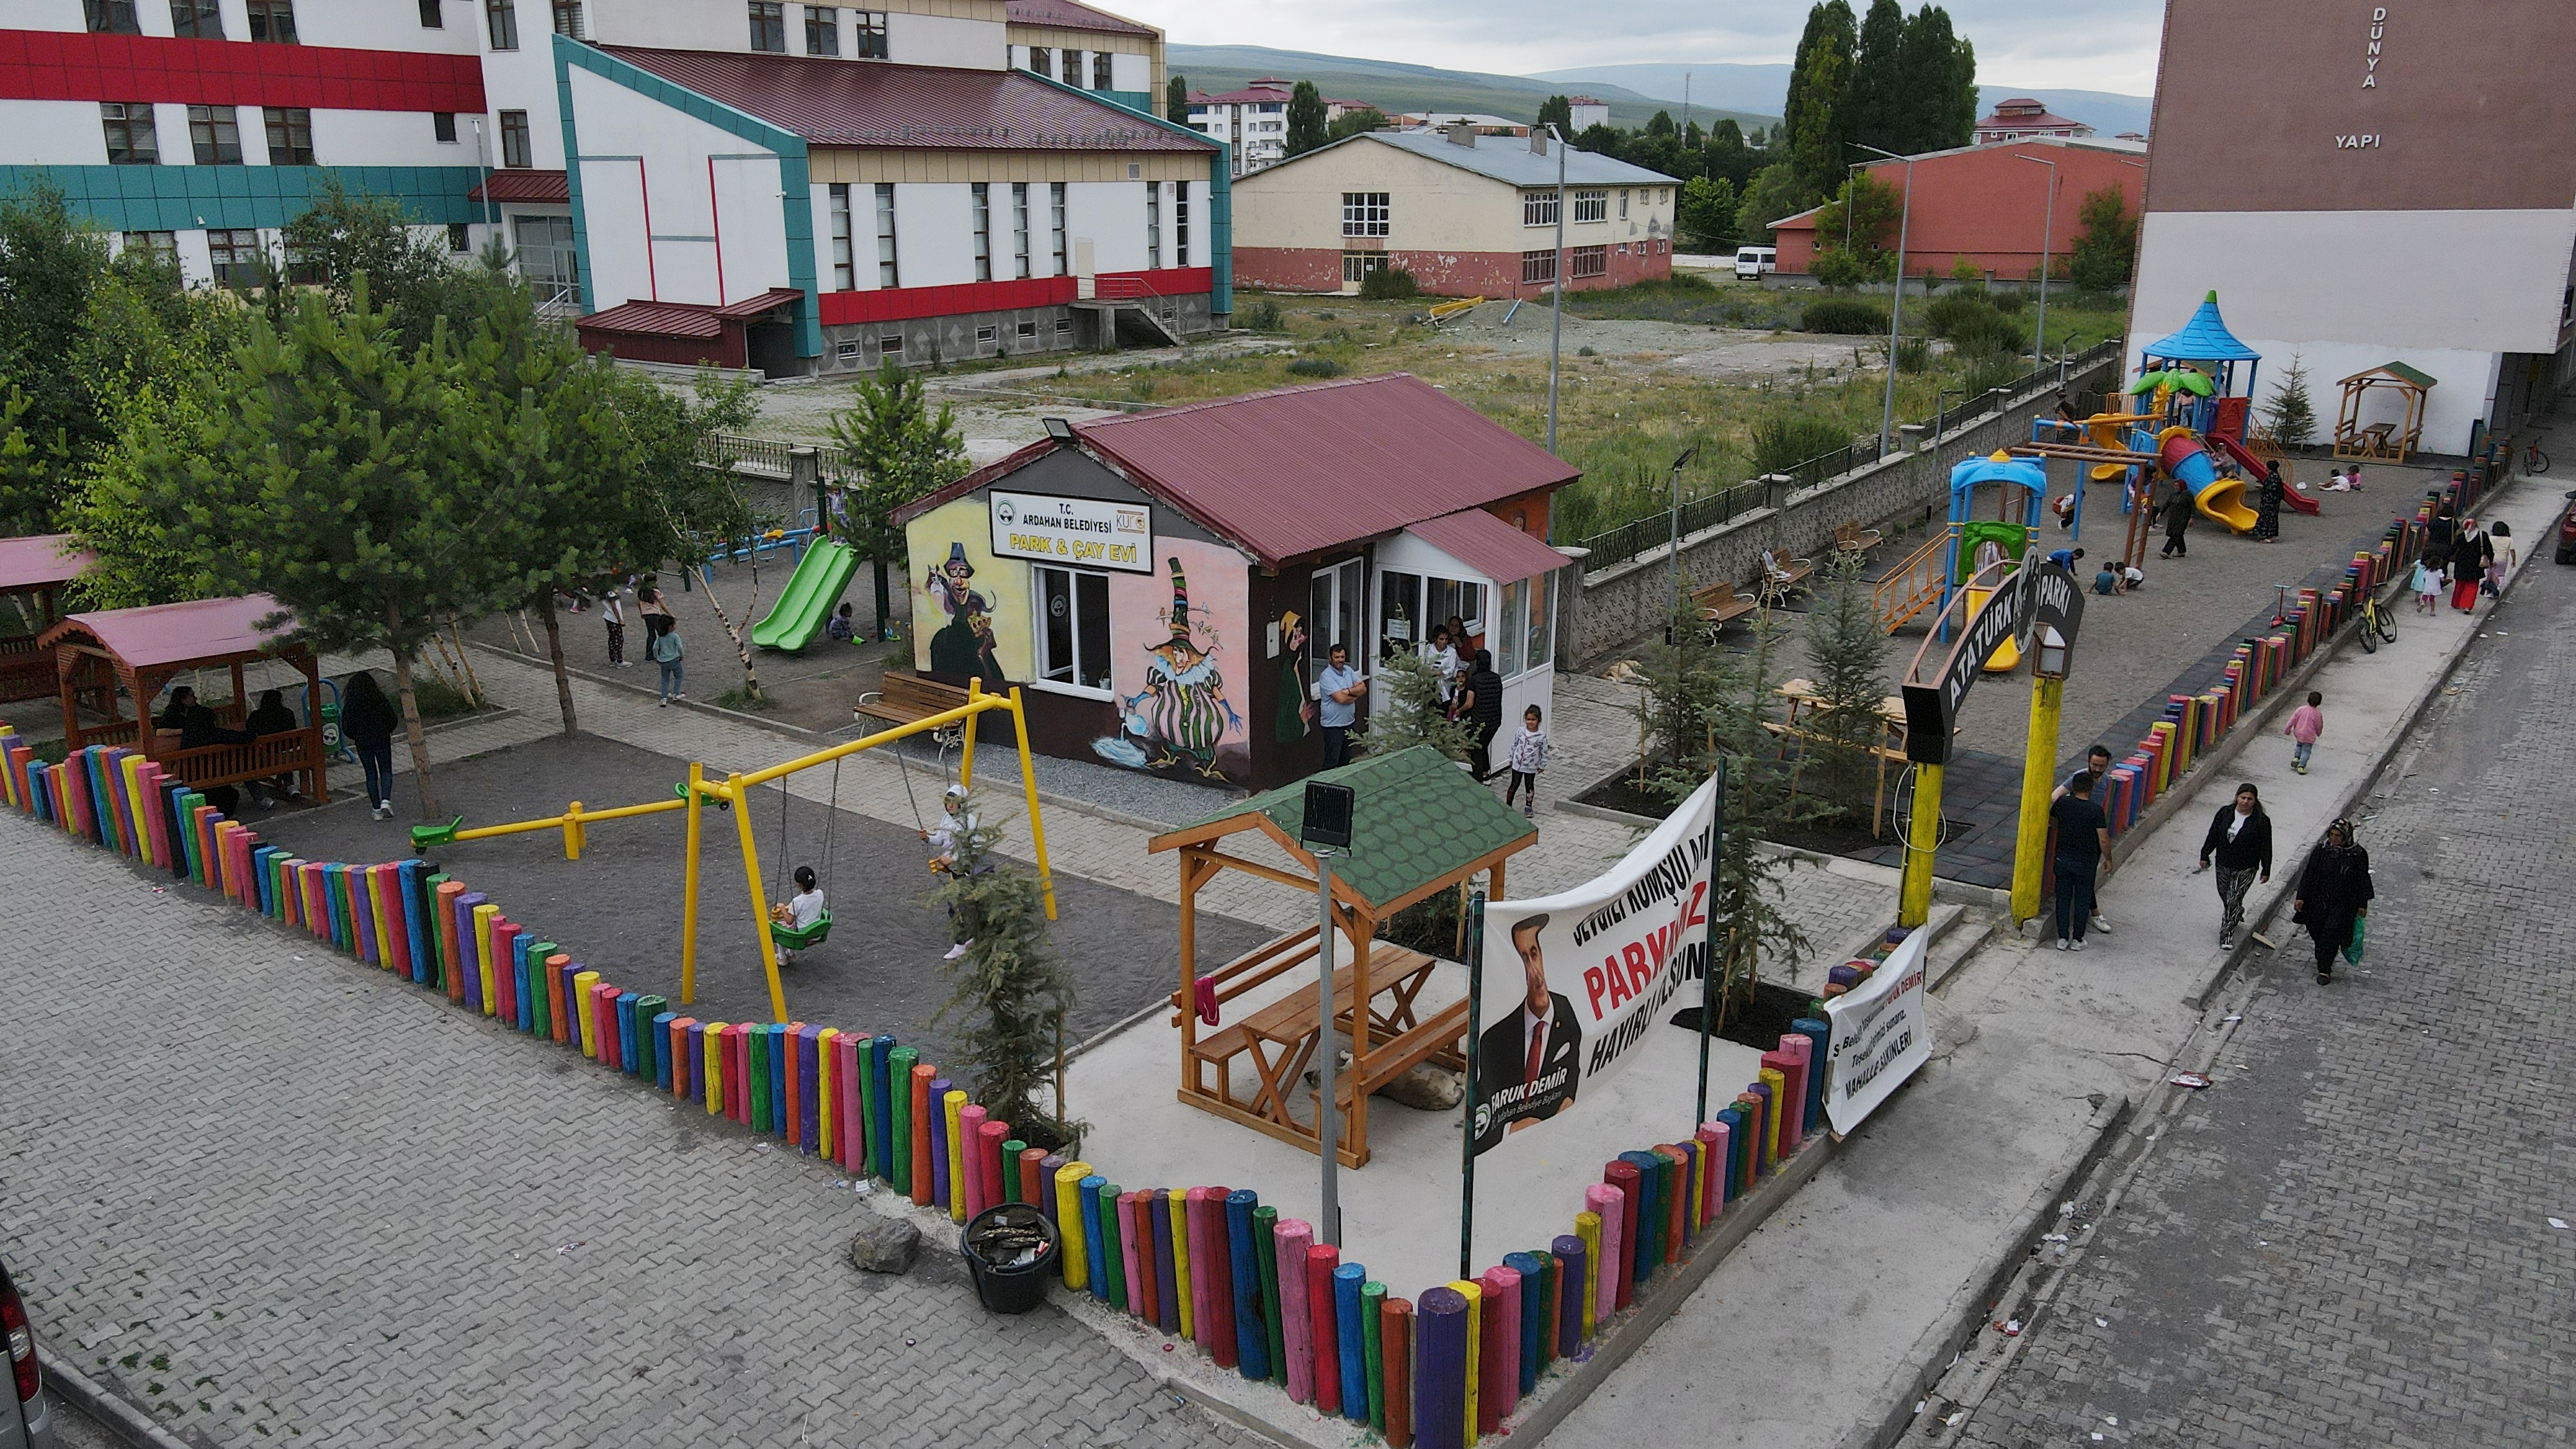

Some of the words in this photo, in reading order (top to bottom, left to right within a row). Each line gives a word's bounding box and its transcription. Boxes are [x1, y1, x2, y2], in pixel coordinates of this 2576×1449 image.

[2362, 7, 2387, 88] DÜNYA
[2335, 134, 2380, 149] YAPI
[1023, 514, 1061, 529] ARDAHAN
[1064, 518, 1112, 534] BELEDİYESİ
[1059, 503, 1074, 515] T.C.
[1010, 533, 1052, 553] PARK
[1056, 538, 1068, 556] &
[1073, 540, 1105, 560] ÇAY
[1109, 543, 1137, 564] EVİ
[2040, 574, 2071, 618] PARKI
[1845, 1059, 1880, 1101] MAHALLE
[1879, 1024, 1913, 1073] SAKİNLERİ
[1492, 1083, 1529, 1115] FARUK
[1528, 1066, 1567, 1097] DEMİR
